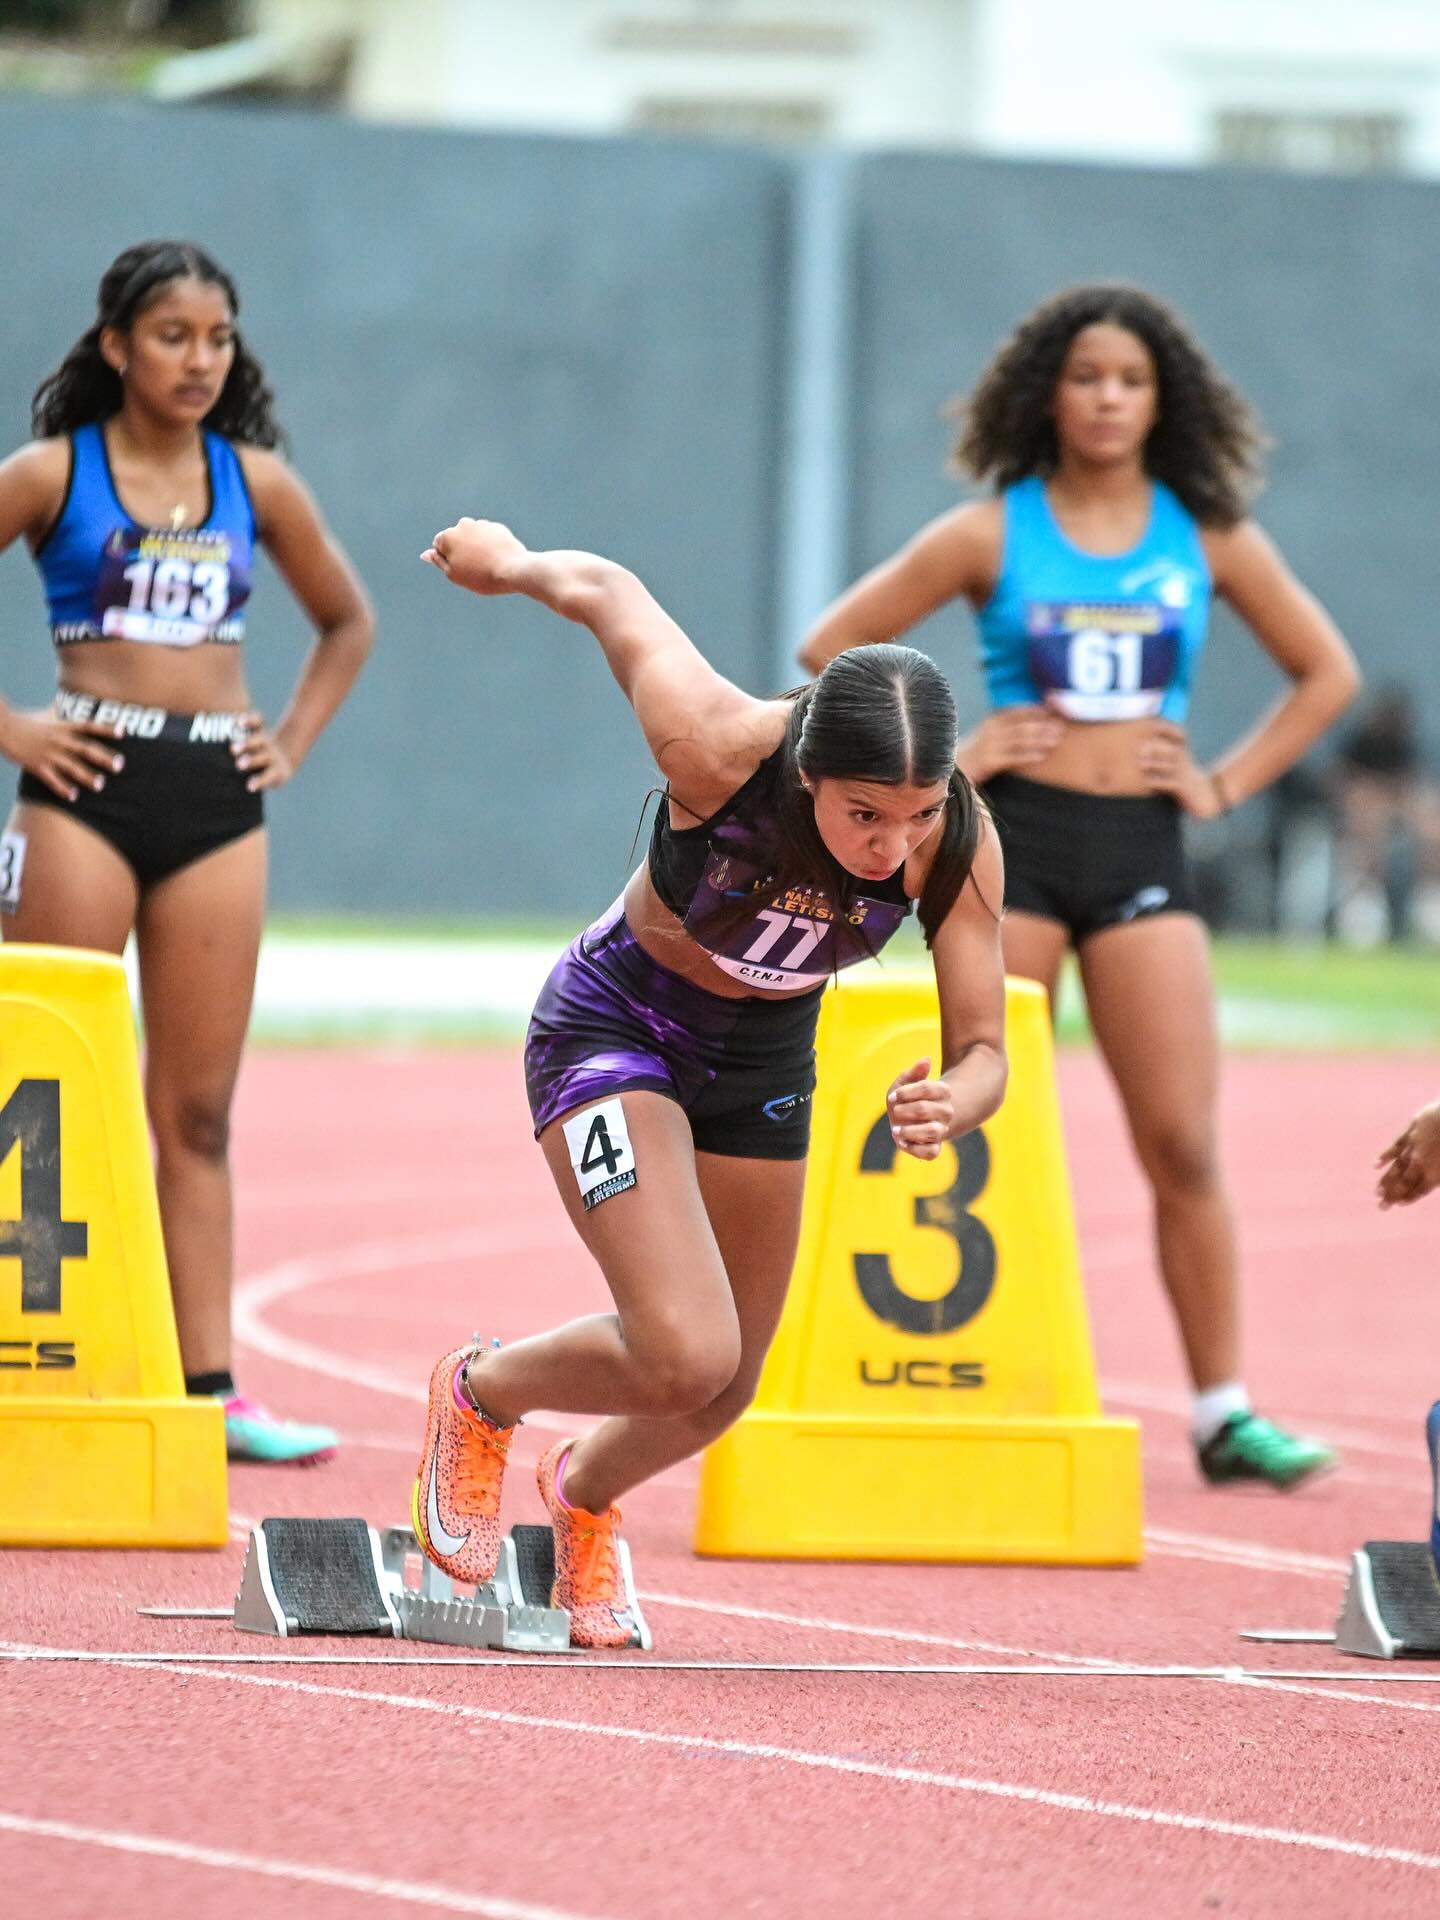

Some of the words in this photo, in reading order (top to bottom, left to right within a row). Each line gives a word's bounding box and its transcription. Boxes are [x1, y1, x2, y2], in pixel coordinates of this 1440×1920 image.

[123, 558, 231, 624] 163
[1067, 629, 1143, 694] 61
[95, 701, 168, 740] PRO
[742, 909, 830, 970] 77
[739, 966, 784, 983] C.T.N.A
[581, 1115, 623, 1175] 4
[0, 1079, 88, 1314] 4
[594, 1179, 636, 1205] ATLETISMO
[853, 1107, 996, 1336] 3
[860, 1360, 985, 1388] UCS
